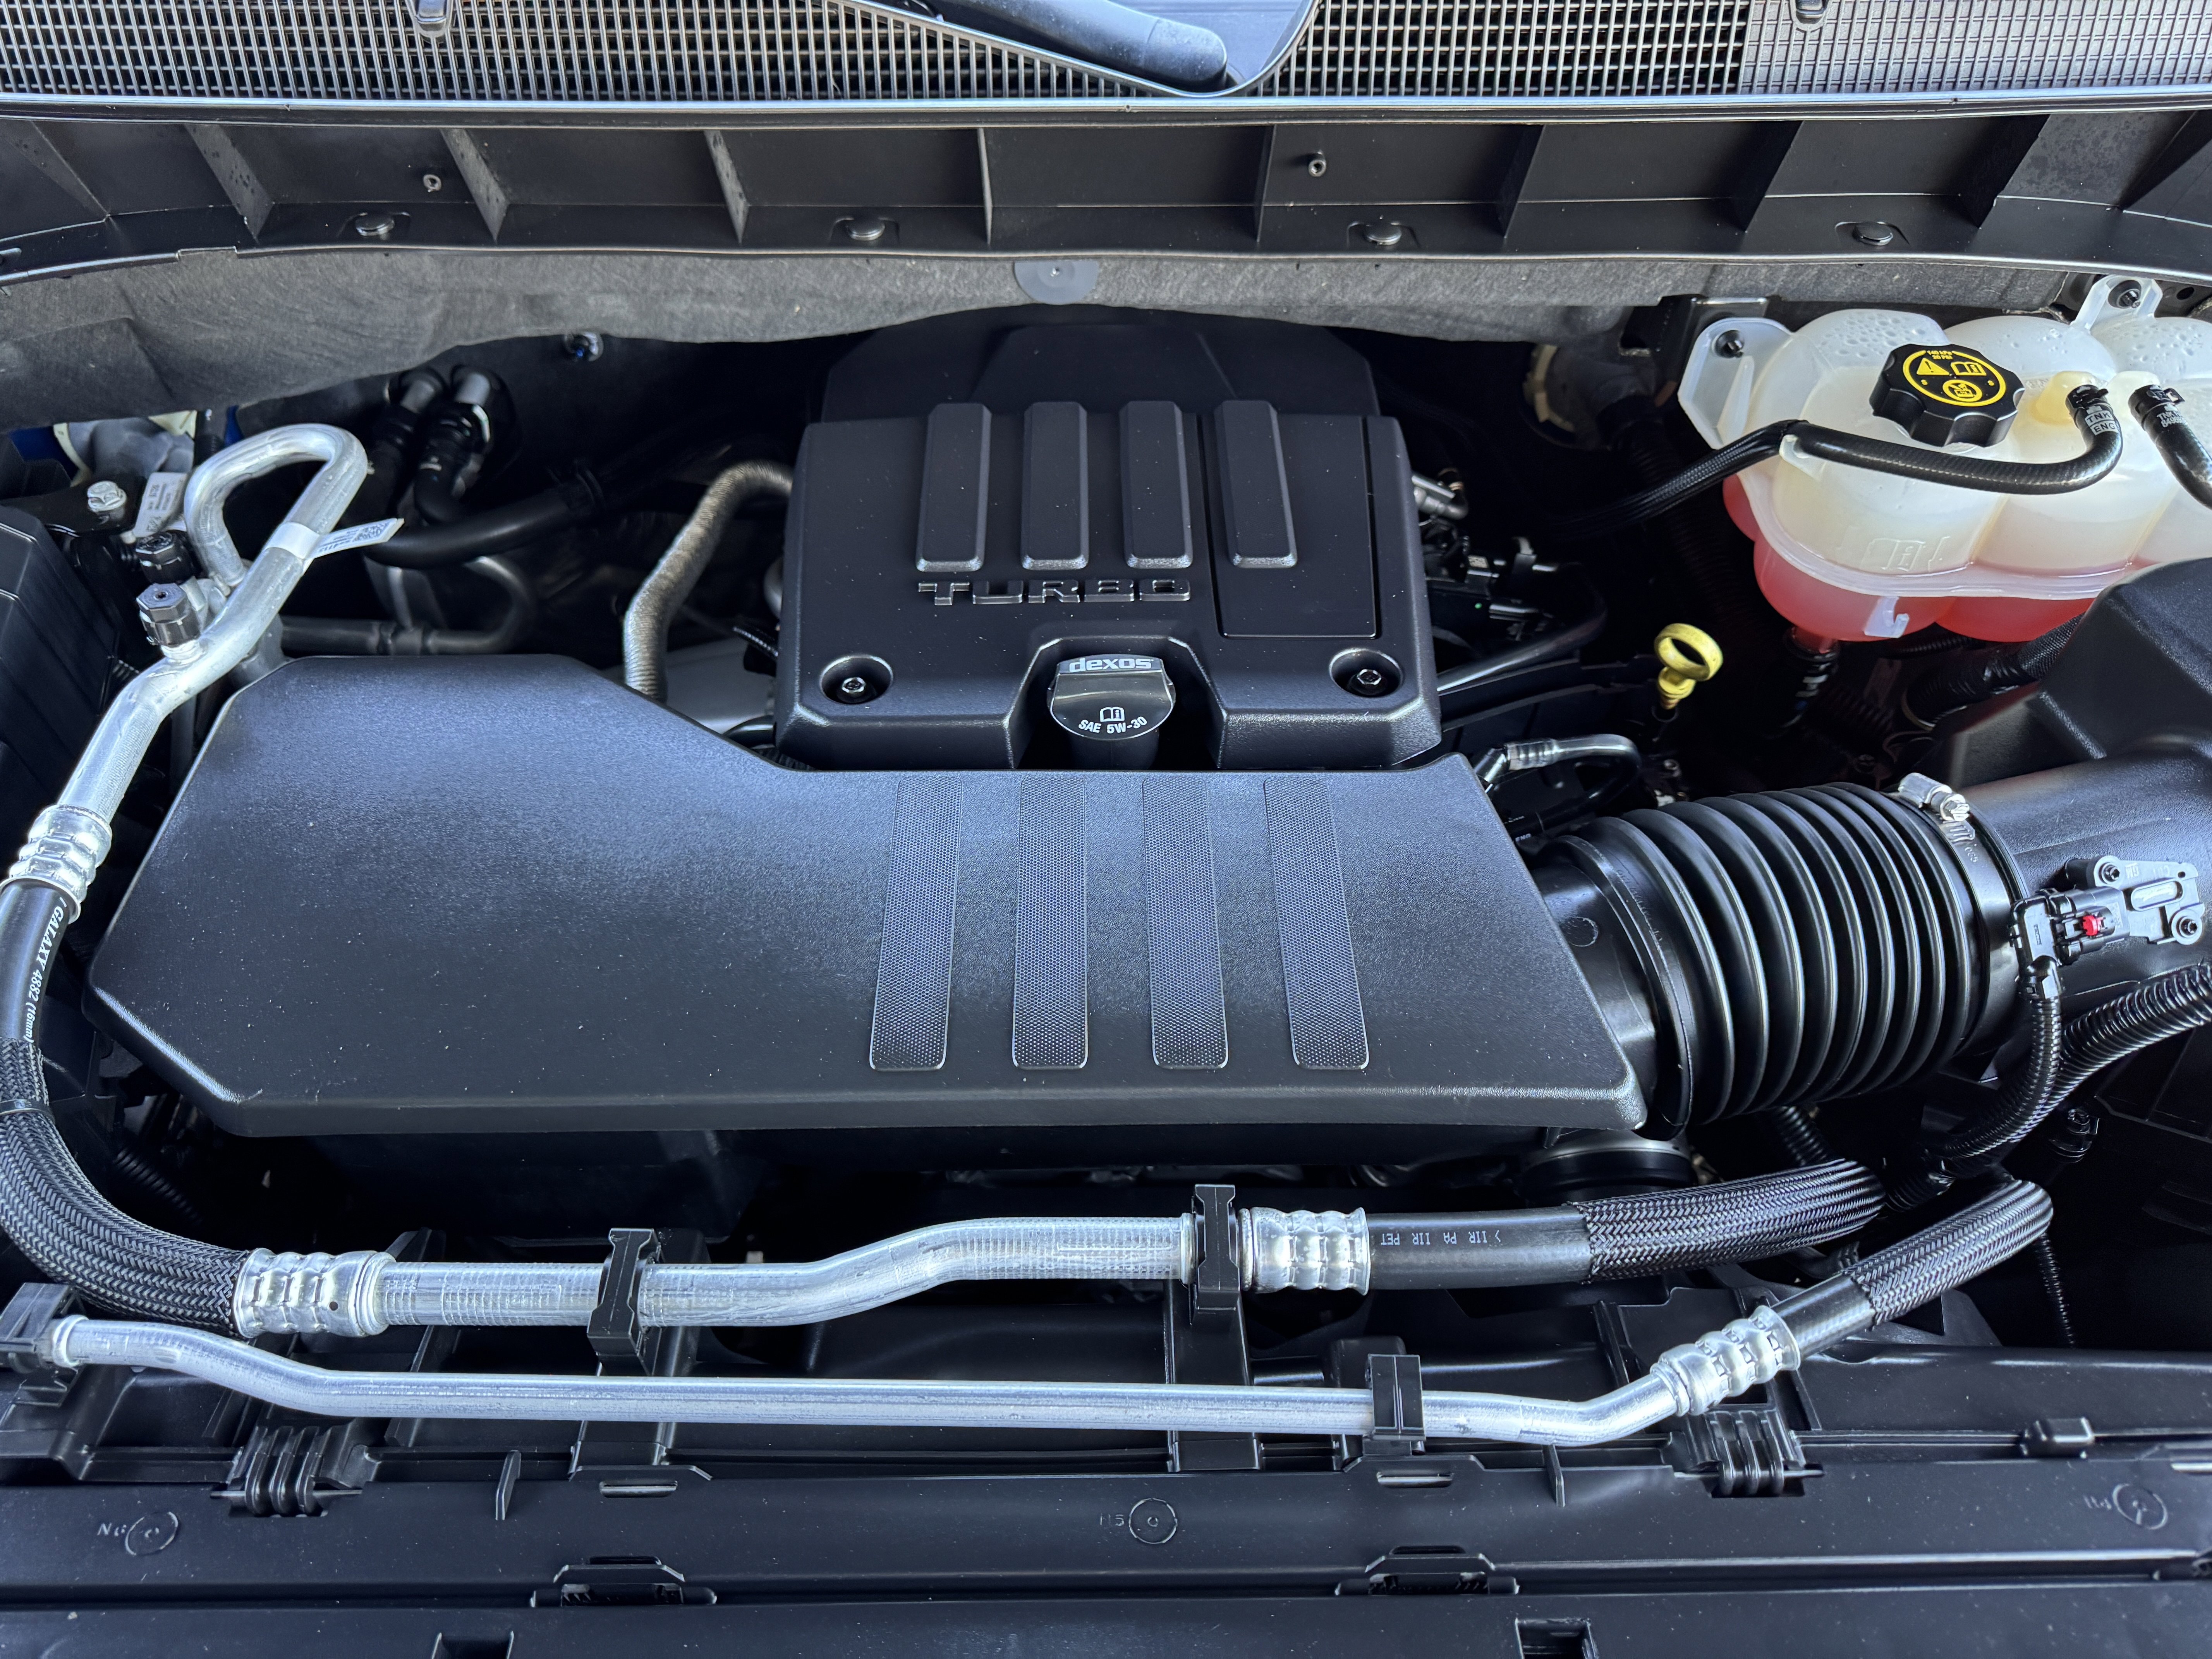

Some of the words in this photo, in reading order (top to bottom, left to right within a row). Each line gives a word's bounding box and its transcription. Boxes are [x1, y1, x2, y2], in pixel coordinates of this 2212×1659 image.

[2087, 412, 2111, 423] TNK
[2093, 423, 2116, 433] ENG
[918, 579, 1191, 606] TURBO
[1069, 658, 1152, 672] dexos
[1078, 720, 1102, 733] SAE
[1107, 716, 1147, 734] 5W-30
[36, 905, 64, 971] GALAXY
[28, 969, 43, 1002] 4882
[23, 1001, 37, 1043] (16mm)
[1381, 1233, 1400, 1246] PET
[1412, 1233, 1431, 1245] IIR
[1443, 1232, 1457, 1244] PA
[1468, 1230, 1487, 1243] IIR
